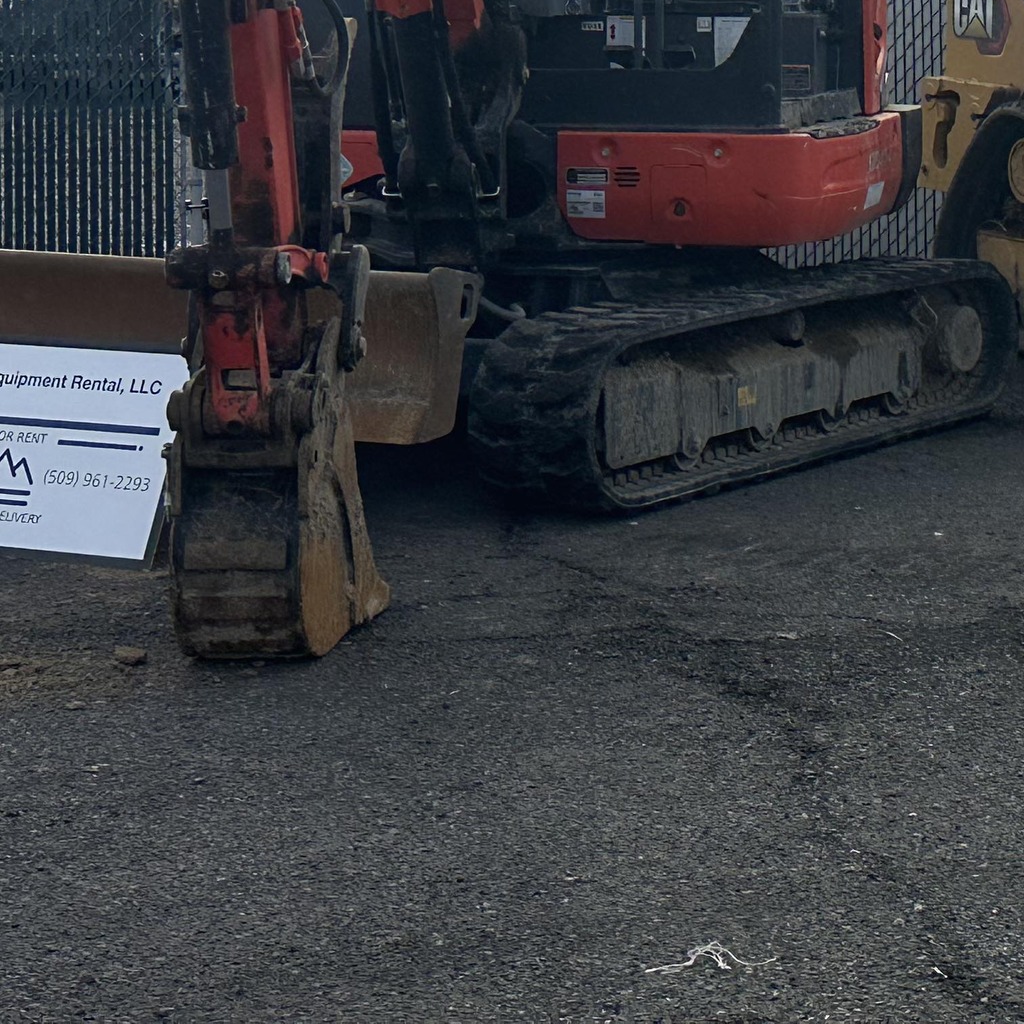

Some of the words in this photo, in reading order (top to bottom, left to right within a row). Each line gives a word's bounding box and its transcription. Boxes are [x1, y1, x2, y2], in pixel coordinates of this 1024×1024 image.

[0, 370, 68, 389] quipment
[70, 375, 124, 395] Rental,
[129, 378, 163, 395] LLC
[0, 430, 14, 442] OR
[16, 431, 48, 444] RENT
[43, 469, 80, 488] (509)
[82, 472, 151, 492] 961-2293
[0, 510, 42, 524] ELIVERY
